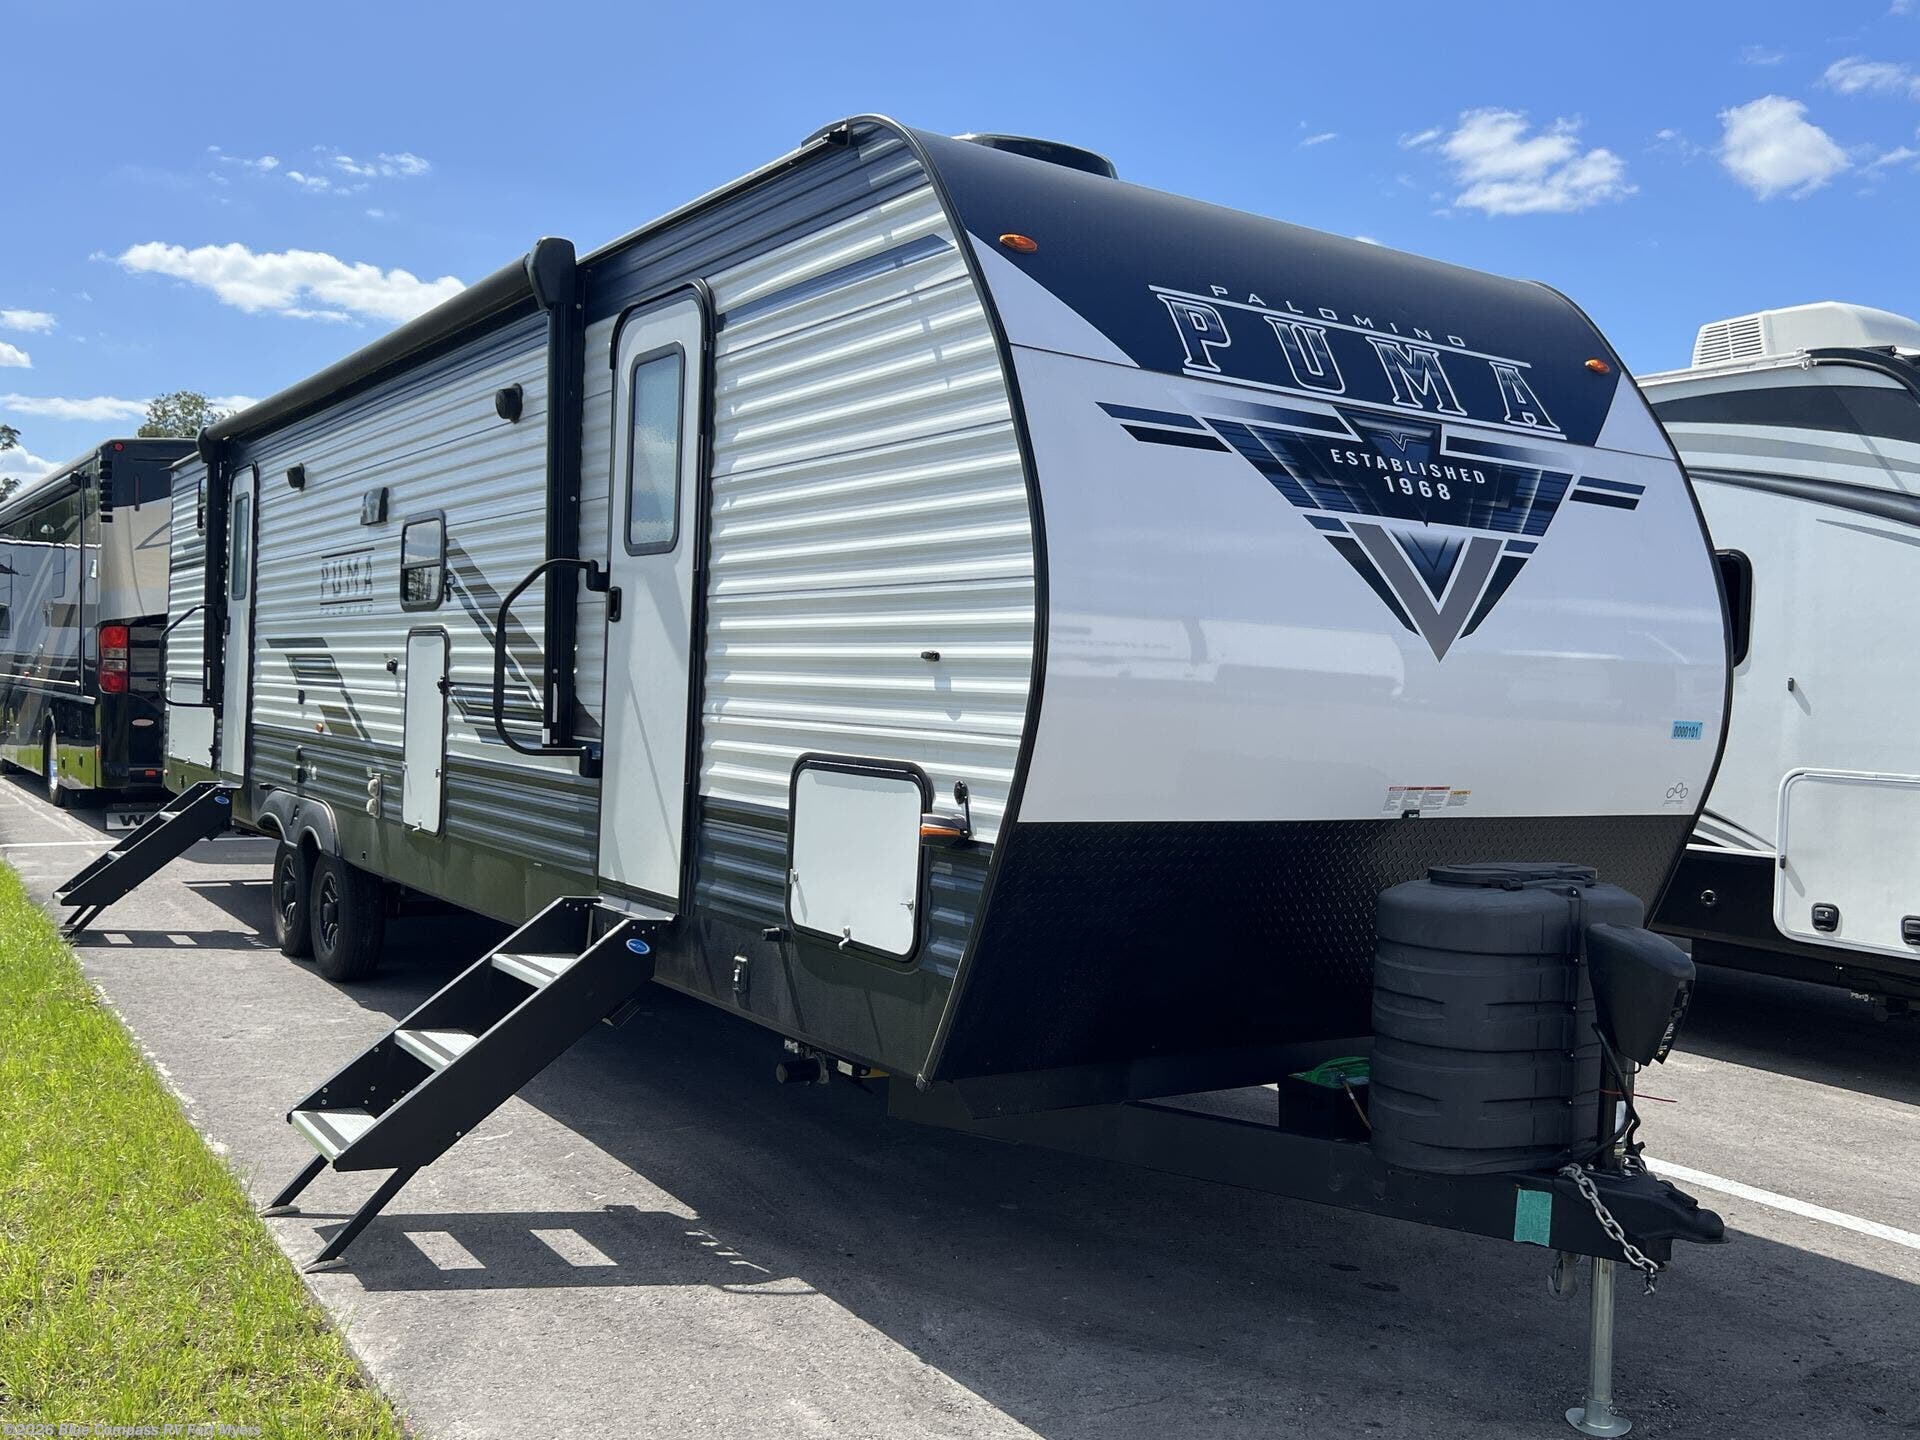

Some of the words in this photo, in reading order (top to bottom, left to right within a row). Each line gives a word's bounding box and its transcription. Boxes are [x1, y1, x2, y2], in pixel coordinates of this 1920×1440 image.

[1210, 284, 1466, 348] PALOMINO
[1156, 292, 1562, 434] PUMA
[1330, 448, 1486, 485] ESTABLISHED
[1384, 475, 1451, 501] 1968
[320, 556, 373, 598] PUMA
